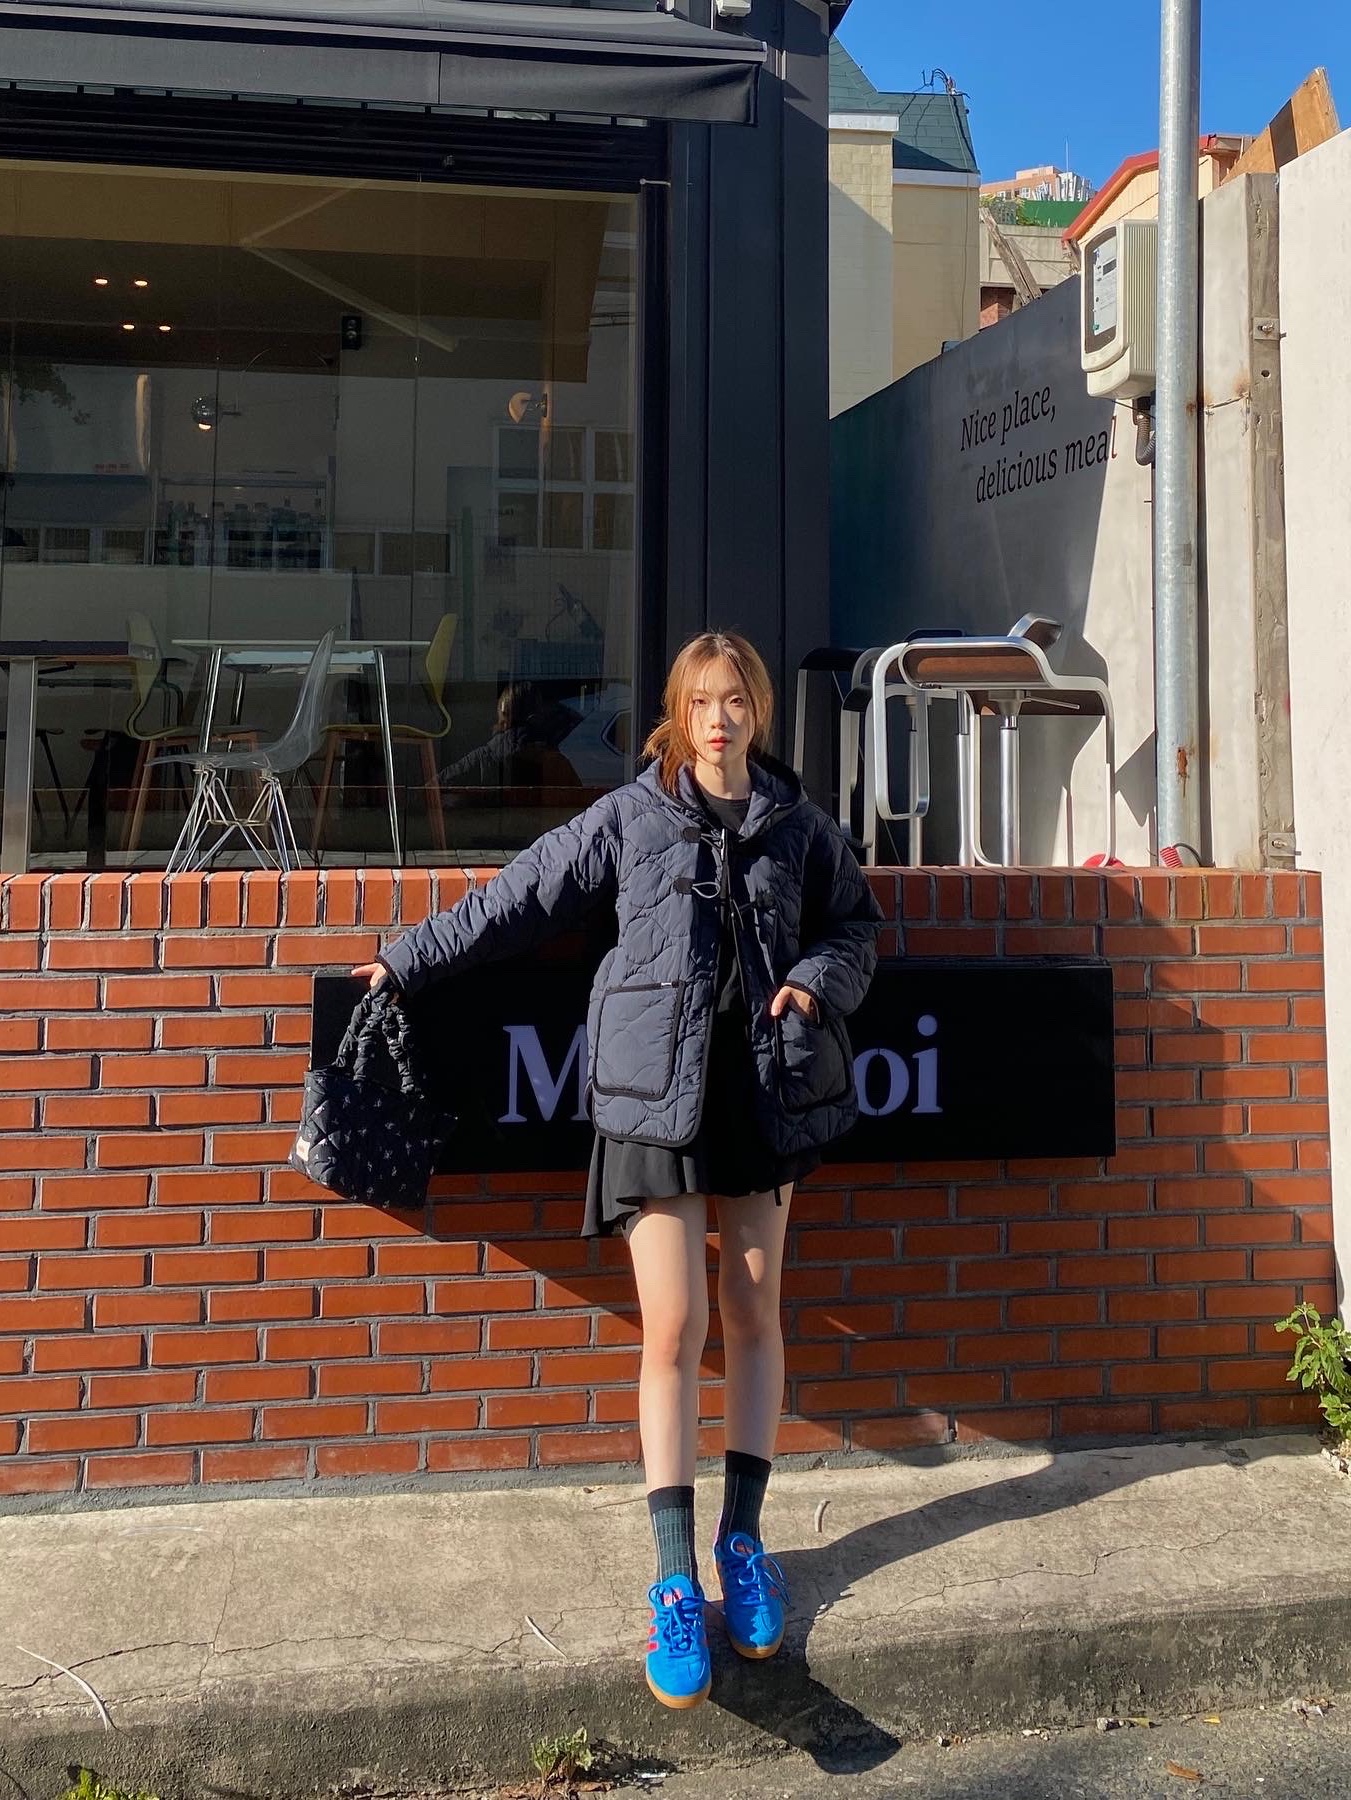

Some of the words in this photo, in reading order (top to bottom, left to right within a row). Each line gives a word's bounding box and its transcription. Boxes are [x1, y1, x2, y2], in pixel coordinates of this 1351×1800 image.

[960, 408, 997, 452] Nice
[1001, 386, 1057, 446] place,
[976, 450, 1058, 504] delicious
[1065, 415, 1118, 475] meal
